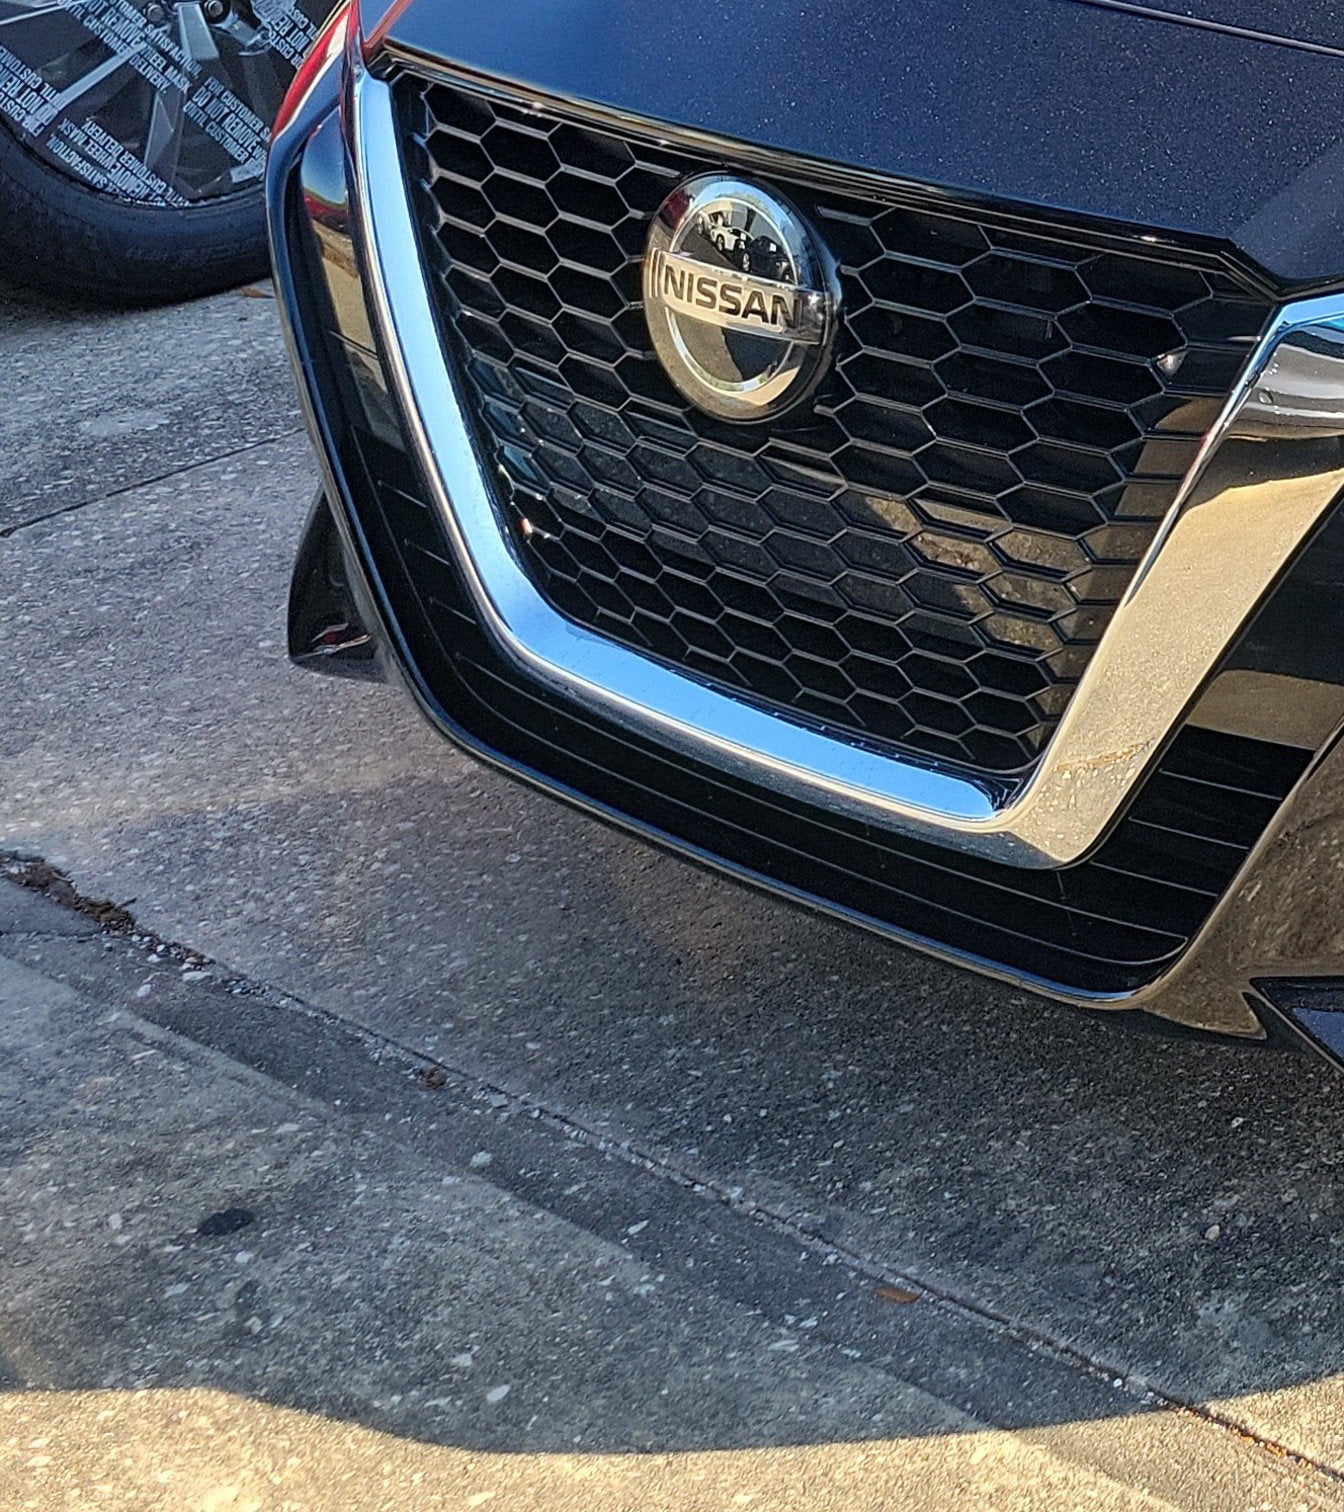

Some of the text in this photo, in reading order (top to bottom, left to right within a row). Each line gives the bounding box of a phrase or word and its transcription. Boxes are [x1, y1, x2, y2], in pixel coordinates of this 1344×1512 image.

[83, 14, 133, 57] CUSTOMER
[129, 53, 171, 94] DELIVERY.
[100, 7, 146, 48] REMOVE
[164, 66, 193, 94] MASK
[144, 24, 203, 80] SATISFACTION,
[15, 86, 44, 115] NOT
[192, 86, 212, 108] DO
[204, 97, 230, 122] NOT
[221, 113, 261, 153] REMOVE
[204, 76, 264, 133] FOR CUSTOMER
[57, 118, 88, 147] MASK
[79, 116, 125, 158] DELIVERY.
[82, 138, 117, 171] WHEEL
[183, 100, 208, 128] UNTIL
[206, 121, 249, 164] CUSTOMER
[47, 134, 108, 189] SATISFACTION,
[120, 150, 168, 193] CUSTOMER
[664, 264, 800, 328] NISSAN
